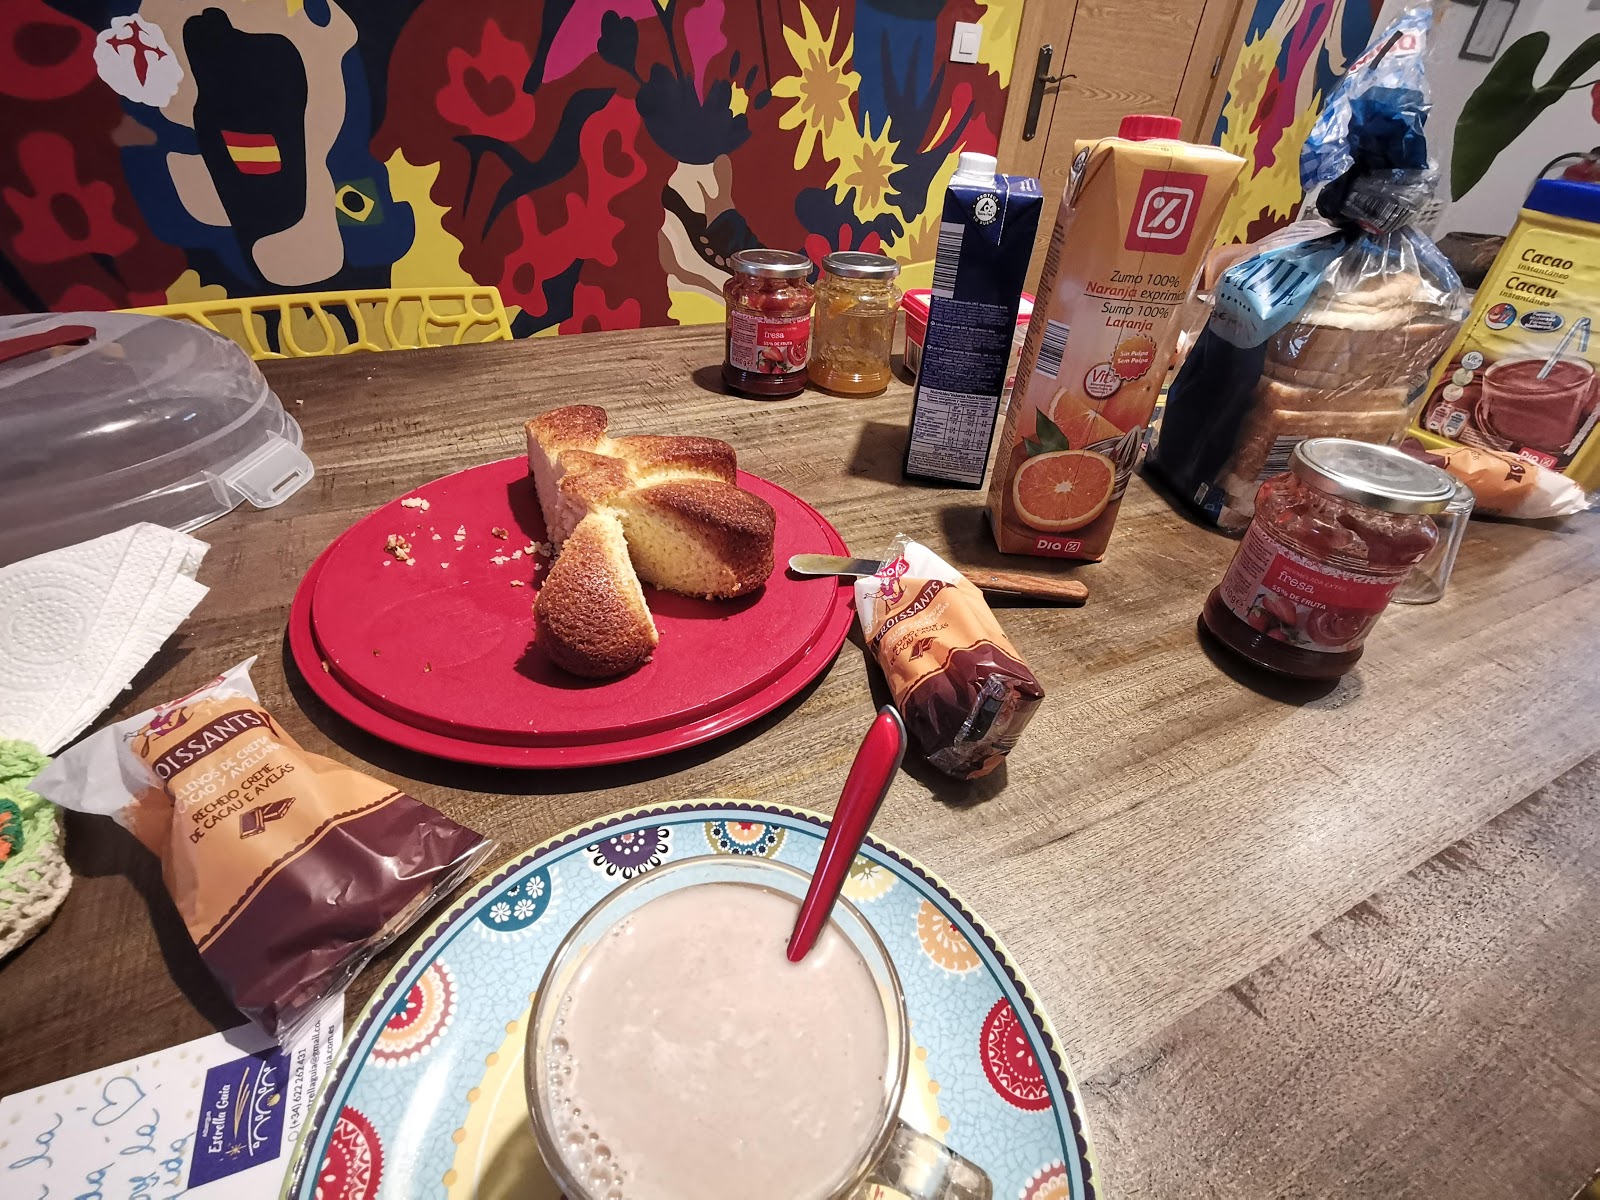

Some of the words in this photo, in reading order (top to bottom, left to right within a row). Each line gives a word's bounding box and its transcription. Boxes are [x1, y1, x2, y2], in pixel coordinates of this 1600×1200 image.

[1521, 249, 1573, 269] Cacao
[1110, 270, 1143, 284] Zumo
[1147, 274, 1180, 287] 100%
[1517, 263, 1569, 280] instantáneo
[1085, 281, 1137, 298] Naranja
[1505, 276, 1558, 299] Cacau
[1101, 302, 1133, 315] Sumo
[1137, 305, 1169, 319] 100%
[1105, 316, 1154, 332] Laranja
[764, 331, 785, 339] fresa
[1277, 570, 1315, 594] fresa
[1271, 584, 1288, 597] 55%
[1289, 593, 1300, 601] DE
[1300, 597, 1327, 610] FRUTA
[875, 581, 940, 641] CROISSANTS
[220, 758, 238, 772] DE
[236, 735, 270, 760] CREMA
[178, 783, 217, 814] CACAO
[218, 775, 227, 787] Y
[189, 827, 206, 844] DE
[203, 800, 244, 829] CACAU
[243, 792, 255, 803] E
[255, 763, 296, 796] AVELÃS
[191, 789, 240, 824] RECHEIO
[240, 763, 275, 790] CREME
[296, 1047, 306, 1065] 431
[294, 1066, 305, 1083] 262
[291, 1083, 303, 1102] 622
[288, 1103, 302, 1129] (+34)
[208, 1111, 227, 1153] Estrella
